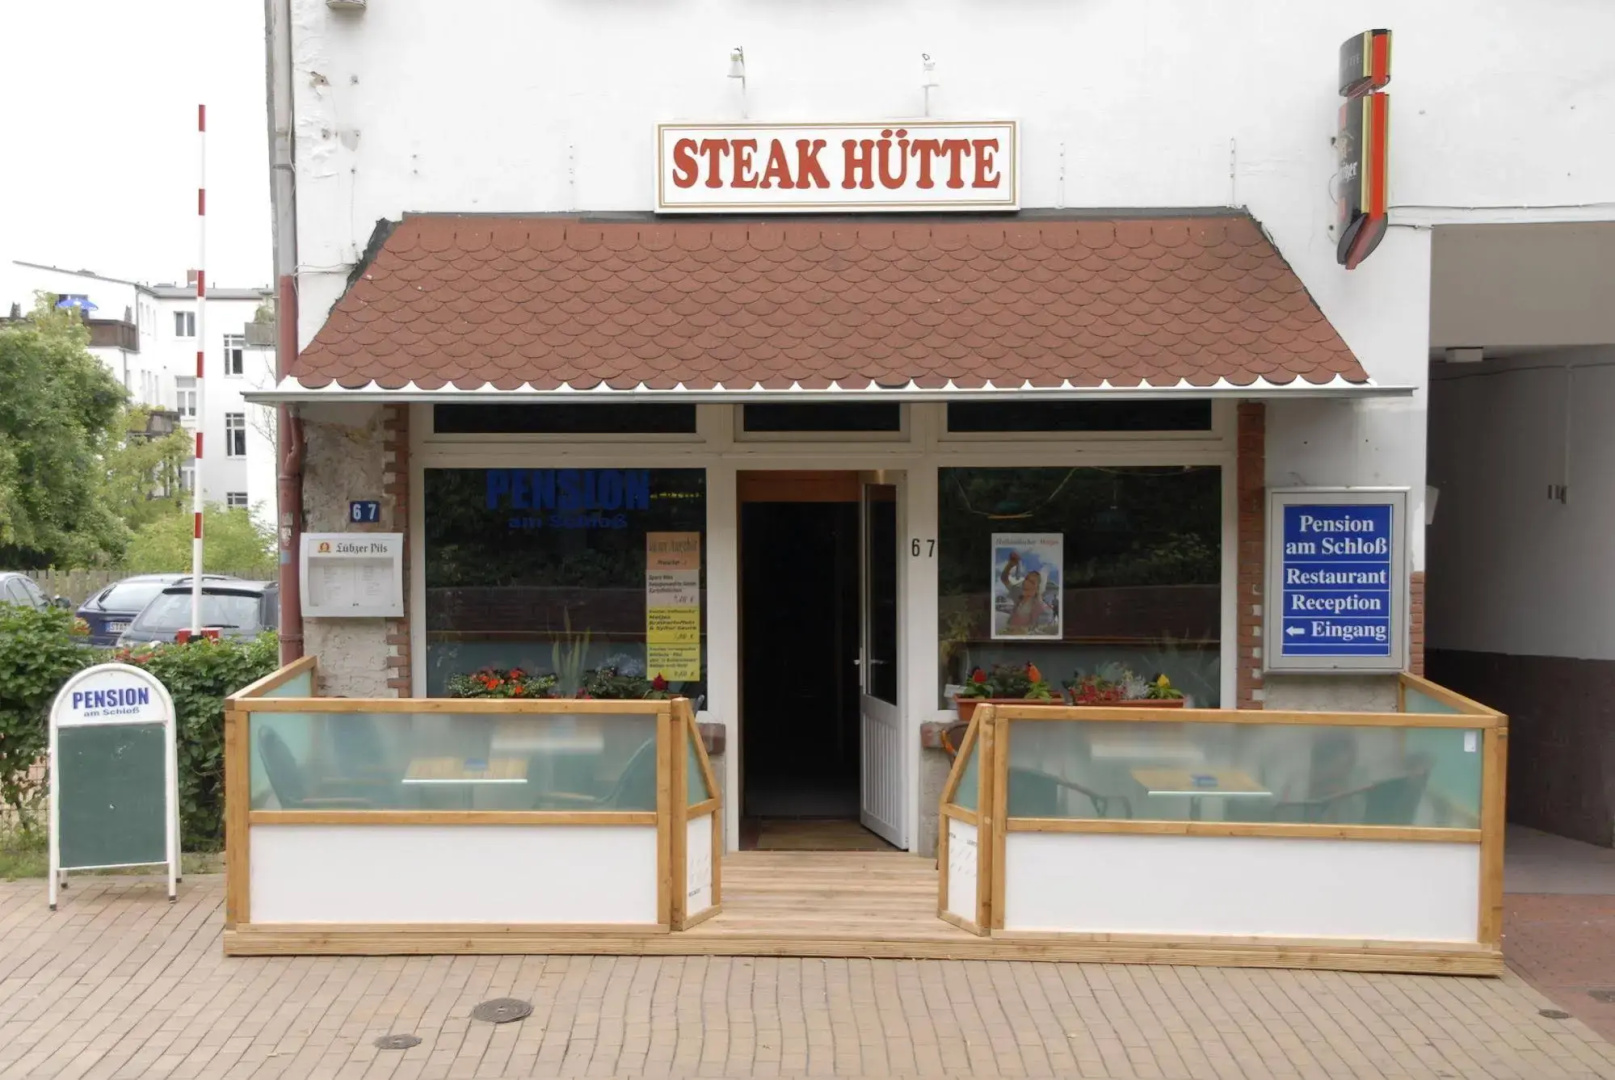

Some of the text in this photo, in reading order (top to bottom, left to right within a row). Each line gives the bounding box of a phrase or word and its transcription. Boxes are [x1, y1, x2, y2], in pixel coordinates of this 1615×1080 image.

[673, 129, 1001, 189] STEAK HÜTTE
[486, 469, 649, 510] PENSION
[508, 517, 542, 529] am
[1299, 515, 1375, 533] Pension
[335, 542, 389, 554] Lübzer Pils
[1285, 537, 1388, 555] am Schloß
[1286, 568, 1387, 585] Restaurant
[1291, 594, 1381, 614] Reception
[1311, 621, 1387, 641] Eingang
[72, 687, 150, 710] PENSION
[84, 706, 140, 718] am Schloß
